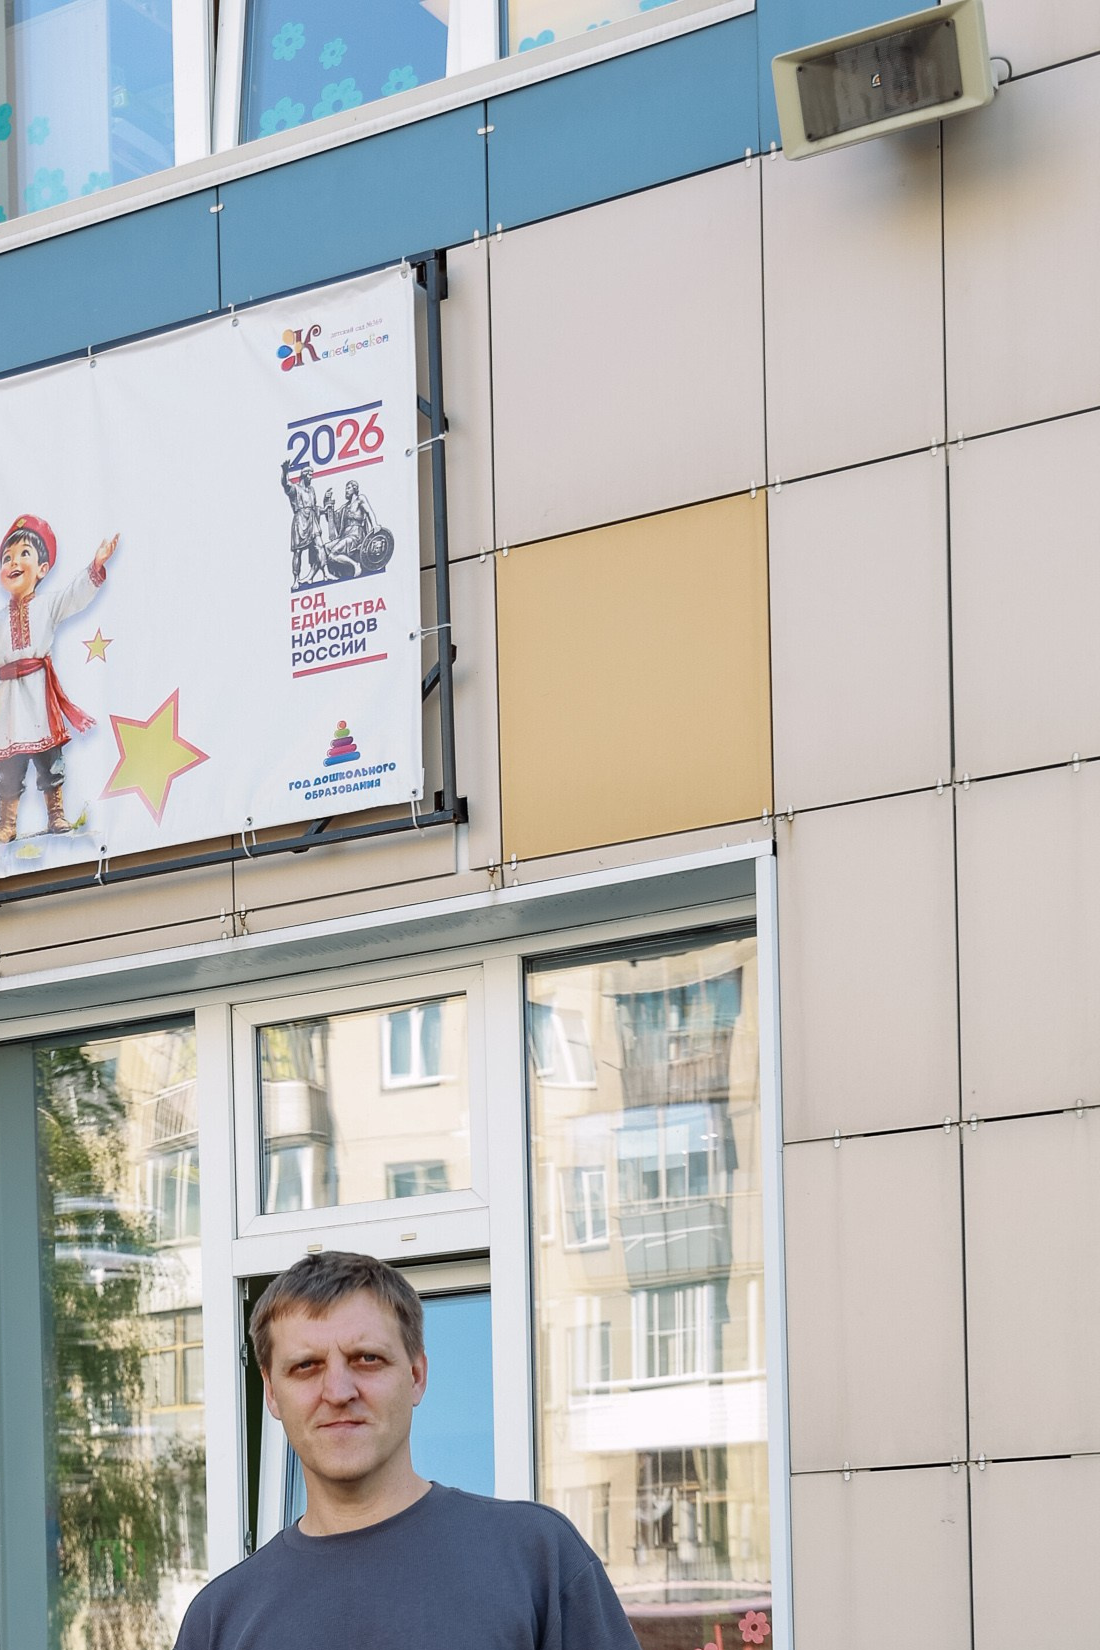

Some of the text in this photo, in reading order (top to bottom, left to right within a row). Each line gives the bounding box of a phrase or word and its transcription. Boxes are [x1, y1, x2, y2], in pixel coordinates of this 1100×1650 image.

[287, 412, 384, 472] 2026
[291, 592, 326, 613] ГОД
[291, 597, 387, 631] ЕДИНСТВА
[291, 618, 378, 649] НАРОДОВ
[292, 637, 366, 667] РОССИИ
[288, 762, 396, 791] ГОД ДОШКОЛЬНОГО
[304, 778, 381, 800] ОБРАЗОВАНИЯ
